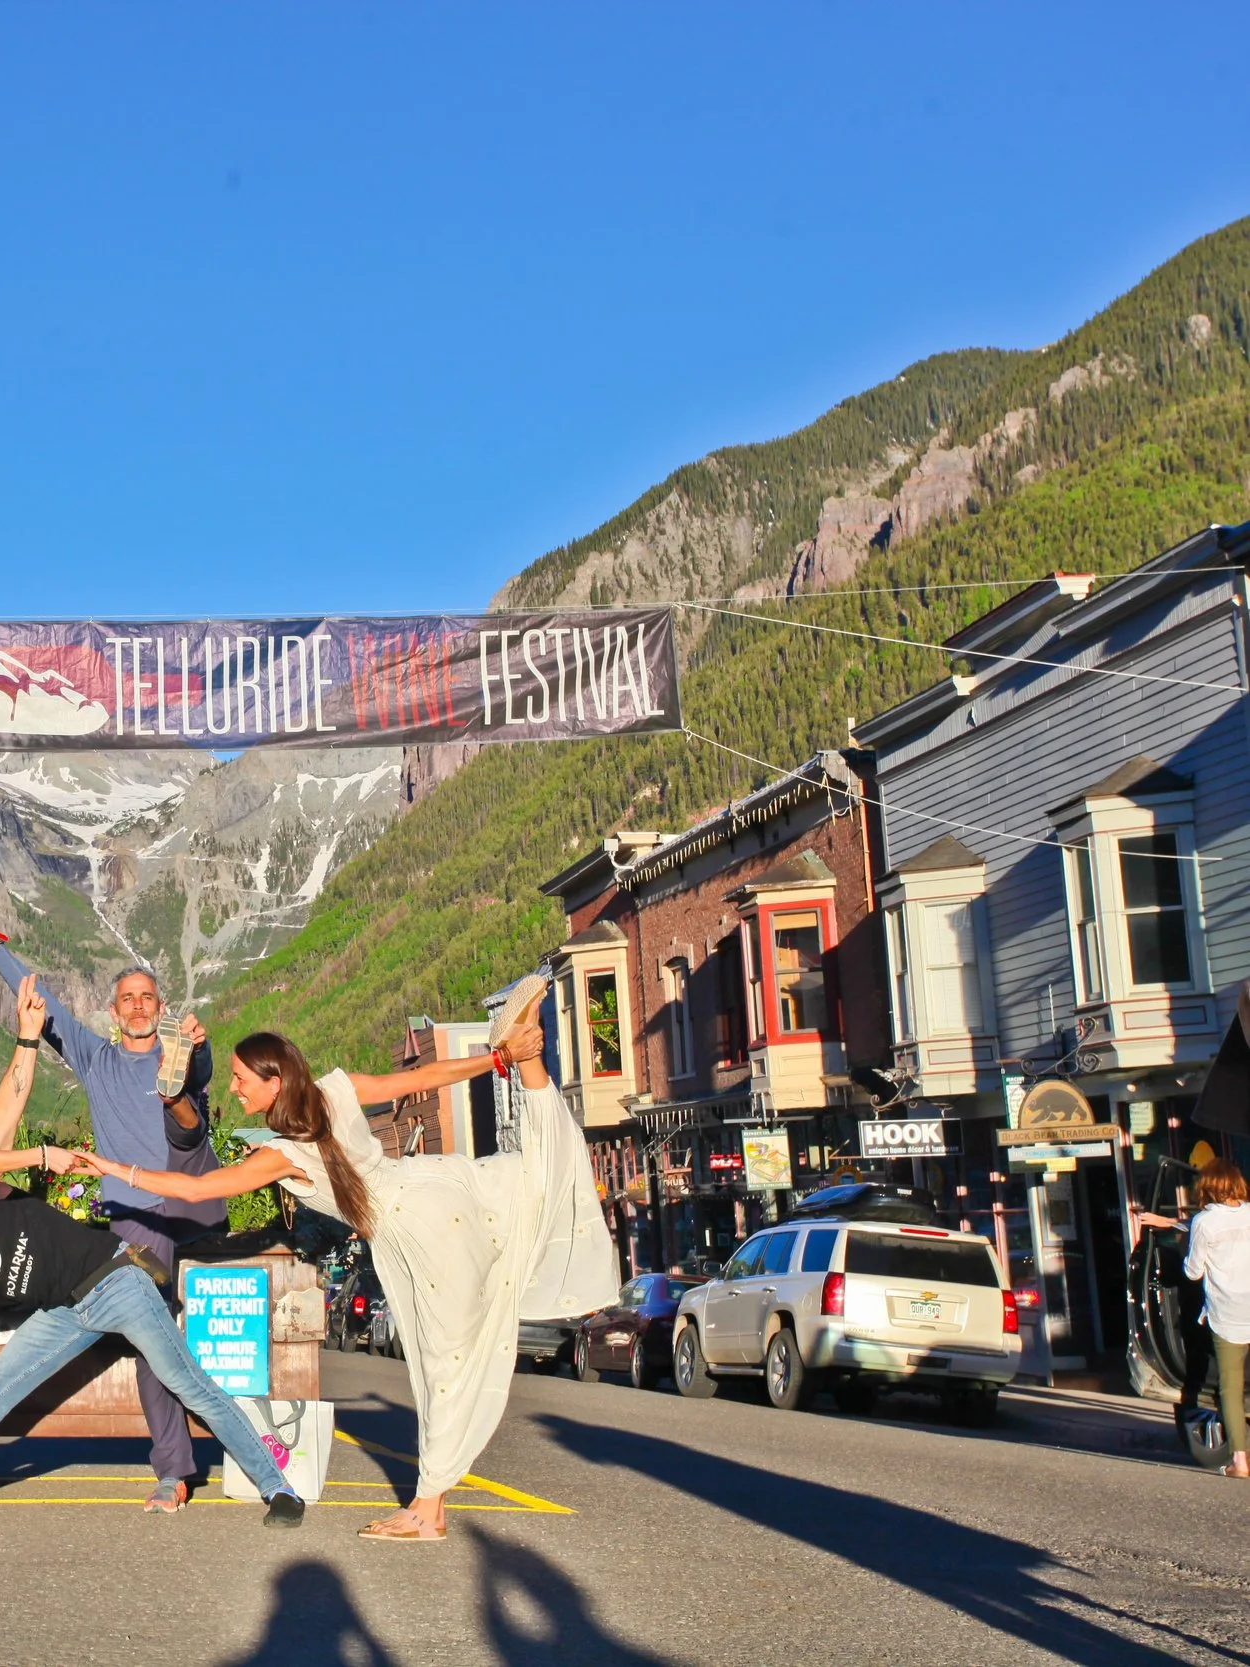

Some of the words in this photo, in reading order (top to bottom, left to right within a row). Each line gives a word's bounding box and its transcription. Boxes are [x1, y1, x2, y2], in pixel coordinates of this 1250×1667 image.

[106, 635, 337, 736] TELLURIDE
[347, 631, 467, 730] WINE
[480, 623, 665, 726] FESTIVAL
[865, 1123, 942, 1145] HOOK
[1001, 1132, 1031, 1142] BLACK
[1034, 1130, 1059, 1140] BEAR
[1059, 1128, 1099, 1139] TRADING
[868, 1147, 889, 1155] unique
[890, 1146, 907, 1154] home
[195, 1277, 257, 1295] PARKING
[187, 1298, 207, 1315] BY
[212, 1298, 266, 1315] PERMIT
[207, 1318, 245, 1335] ONLY
[197, 1341, 213, 1355] 30
[216, 1341, 258, 1355] MINUTE
[200, 1356, 255, 1370] MAXIMUM
